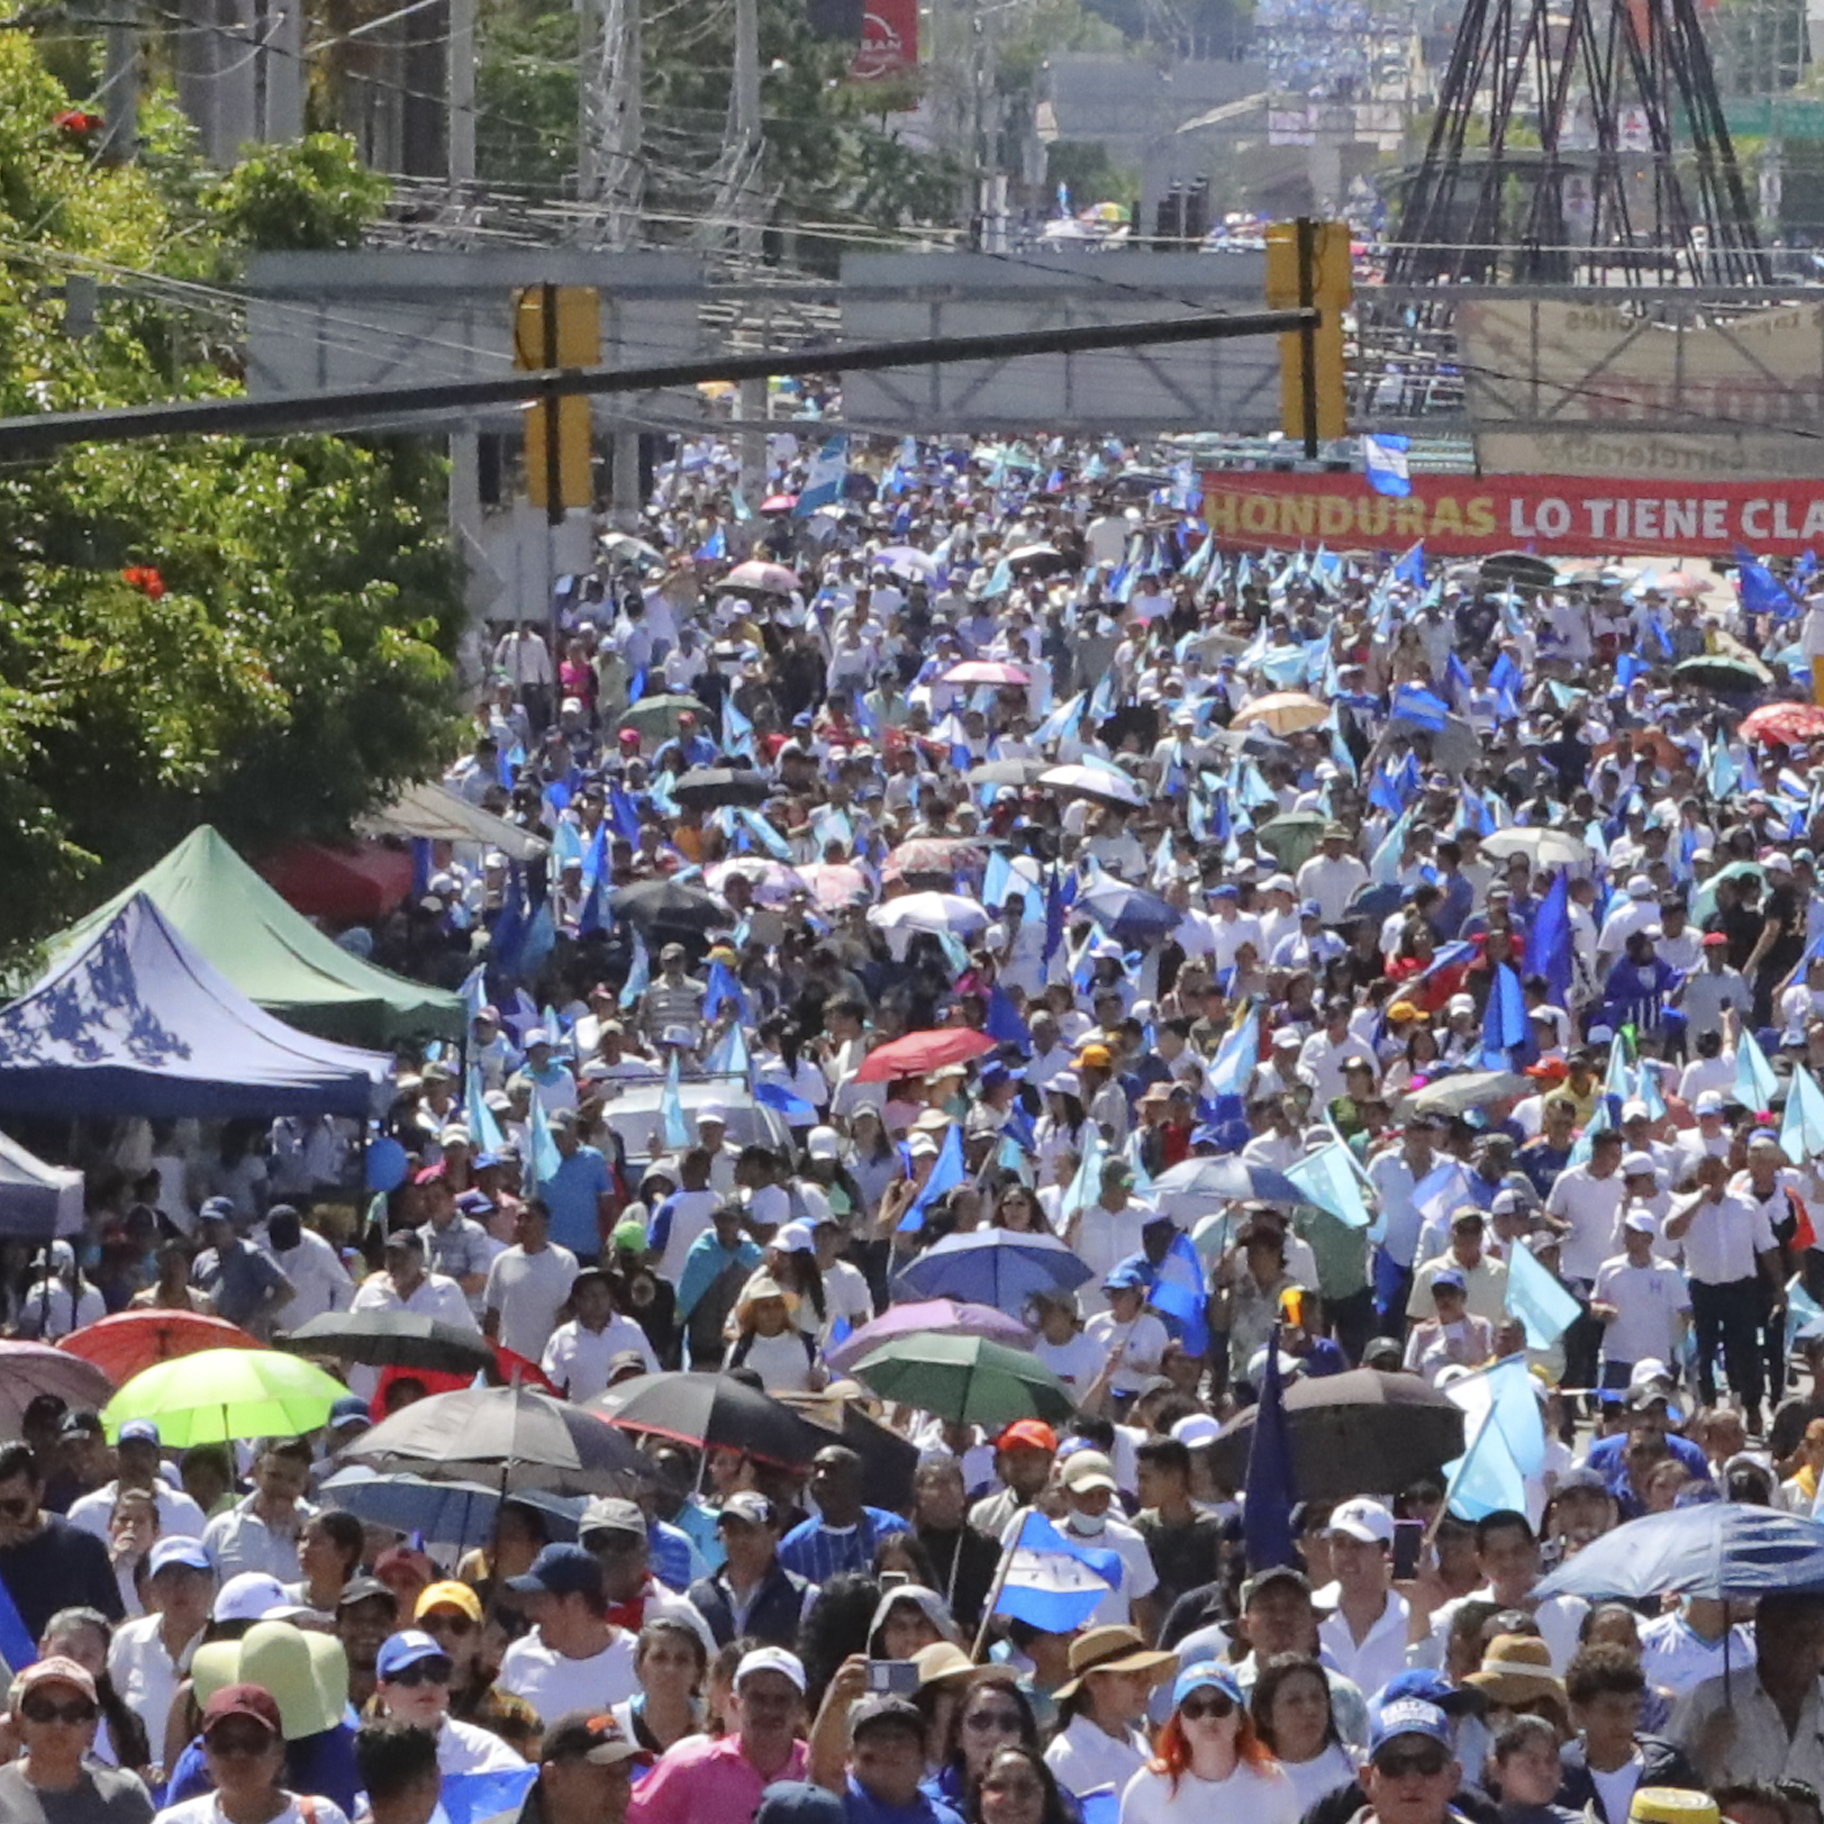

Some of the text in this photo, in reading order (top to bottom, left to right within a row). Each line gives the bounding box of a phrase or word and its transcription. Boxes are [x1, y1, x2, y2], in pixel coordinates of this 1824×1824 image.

[1204, 495, 1496, 538] HONDURAS
[1510, 498, 1572, 538] LO
[1584, 497, 1729, 540] TIENE
